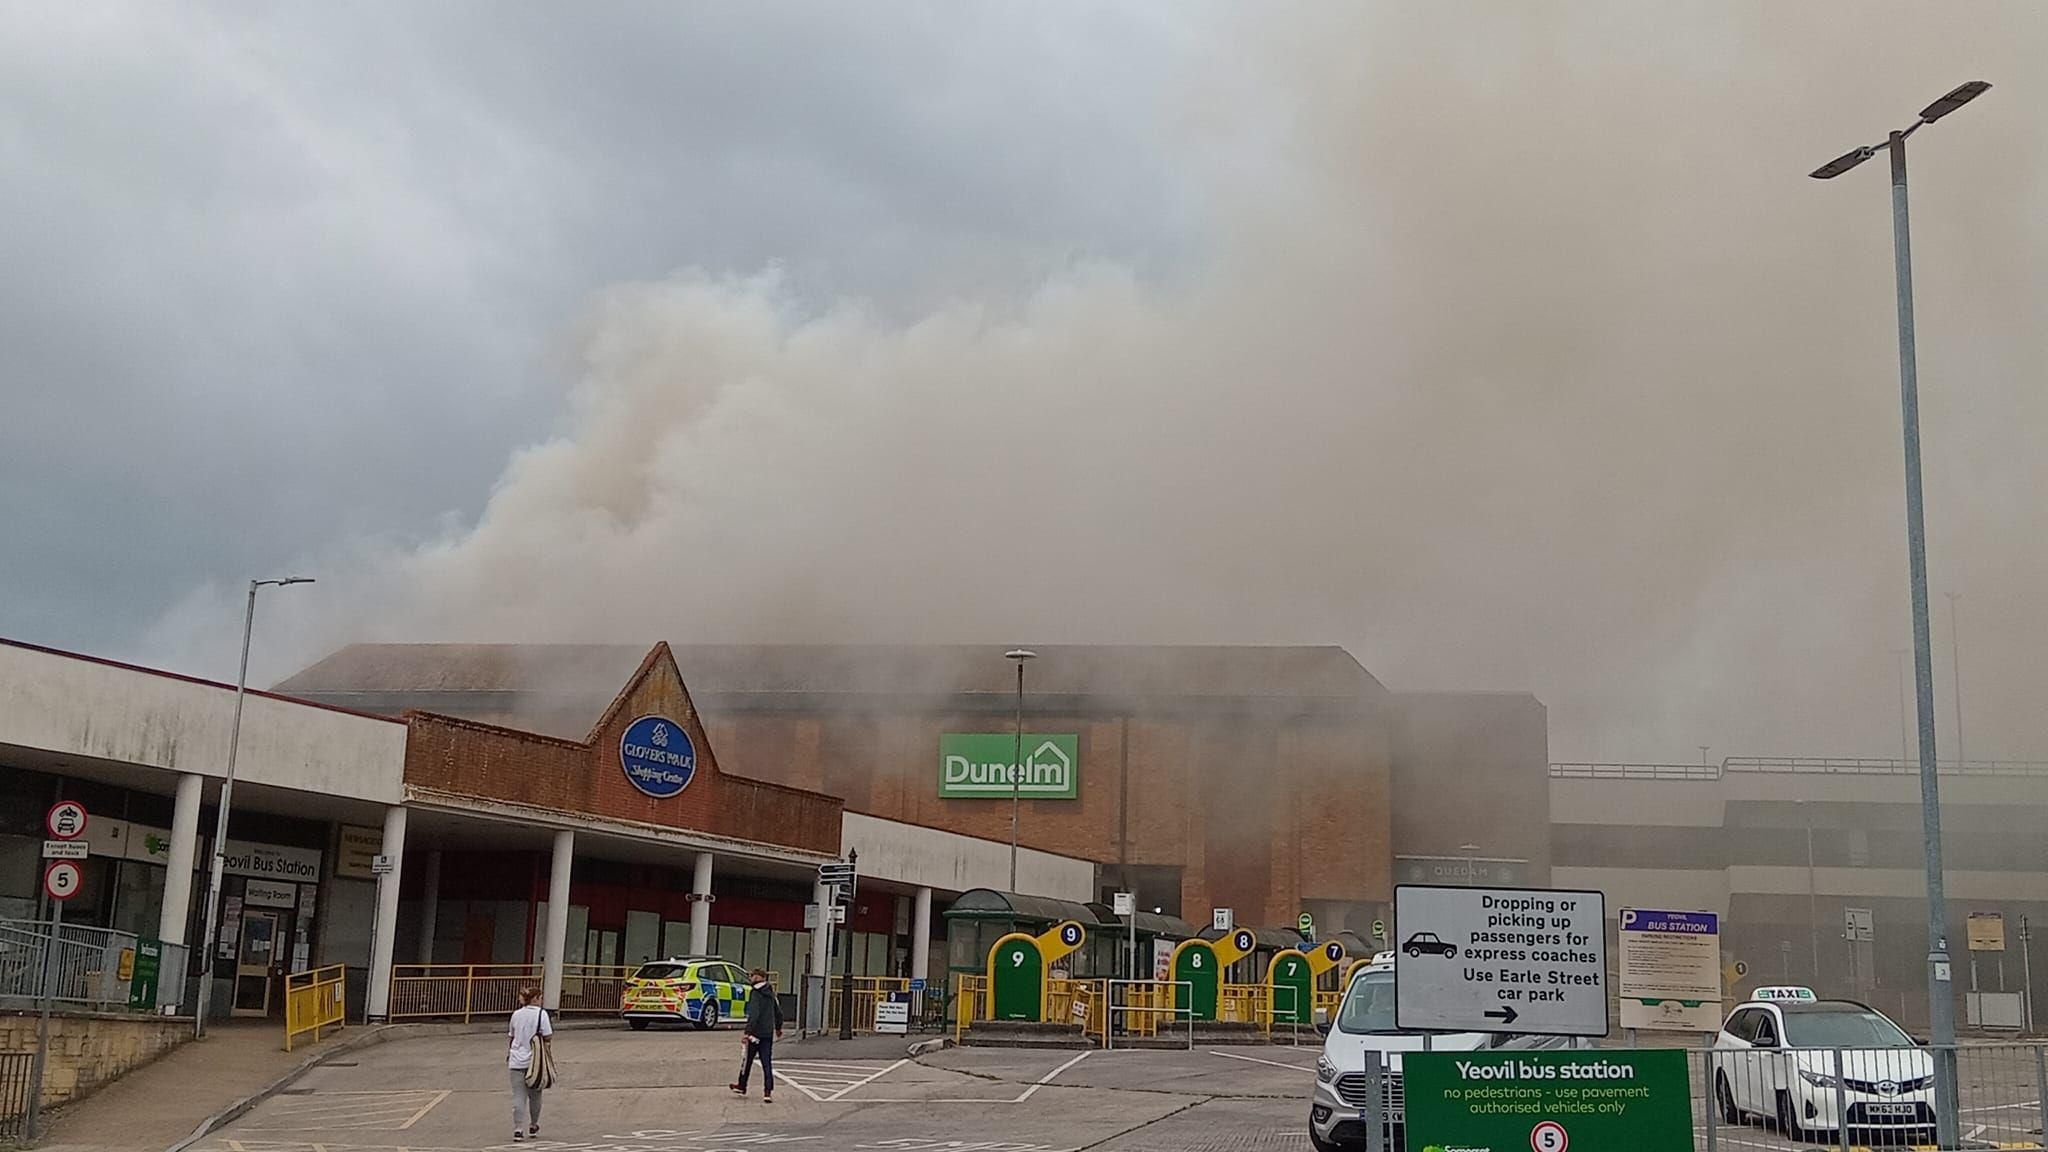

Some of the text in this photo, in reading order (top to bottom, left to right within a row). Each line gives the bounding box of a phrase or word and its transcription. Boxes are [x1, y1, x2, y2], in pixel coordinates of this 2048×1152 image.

[624, 744, 692, 769] GLOVERS WALK
[945, 754, 1063, 784] Dunelm
[223, 855, 316, 877] eovil Bus Station
[57, 872, 69, 888] 5
[1482, 895, 1577, 913] Dropping or
[1488, 912, 1572, 930] picking up
[1647, 921, 1708, 933] BUS STATION
[1066, 927, 1076, 942] 9
[1239, 935, 1249, 949] 8
[1470, 931, 1590, 946] passengers for
[1012, 951, 1025, 968] 9
[1330, 946, 1339, 958] 7
[1464, 948, 1597, 964] express coaches
[1192, 953, 1202, 968] 8
[1287, 963, 1297, 977] 7
[1463, 967, 1600, 986] Use Earle Street
[890, 992, 897, 1002] 9
[1497, 988, 1566, 1003] car park
[1769, 989, 1800, 999] TAXI
[1456, 1061, 1634, 1080] Yeovil bus station
[1444, 1087, 1461, 1099] no
[1465, 1086, 1542, 1104] pedestrians
[1555, 1087, 1578, 1098] use
[1582, 1086, 1650, 1103] pavement
[1470, 1101, 1626, 1115] authorised vehicles only
[1544, 1132, 1555, 1148] 5
